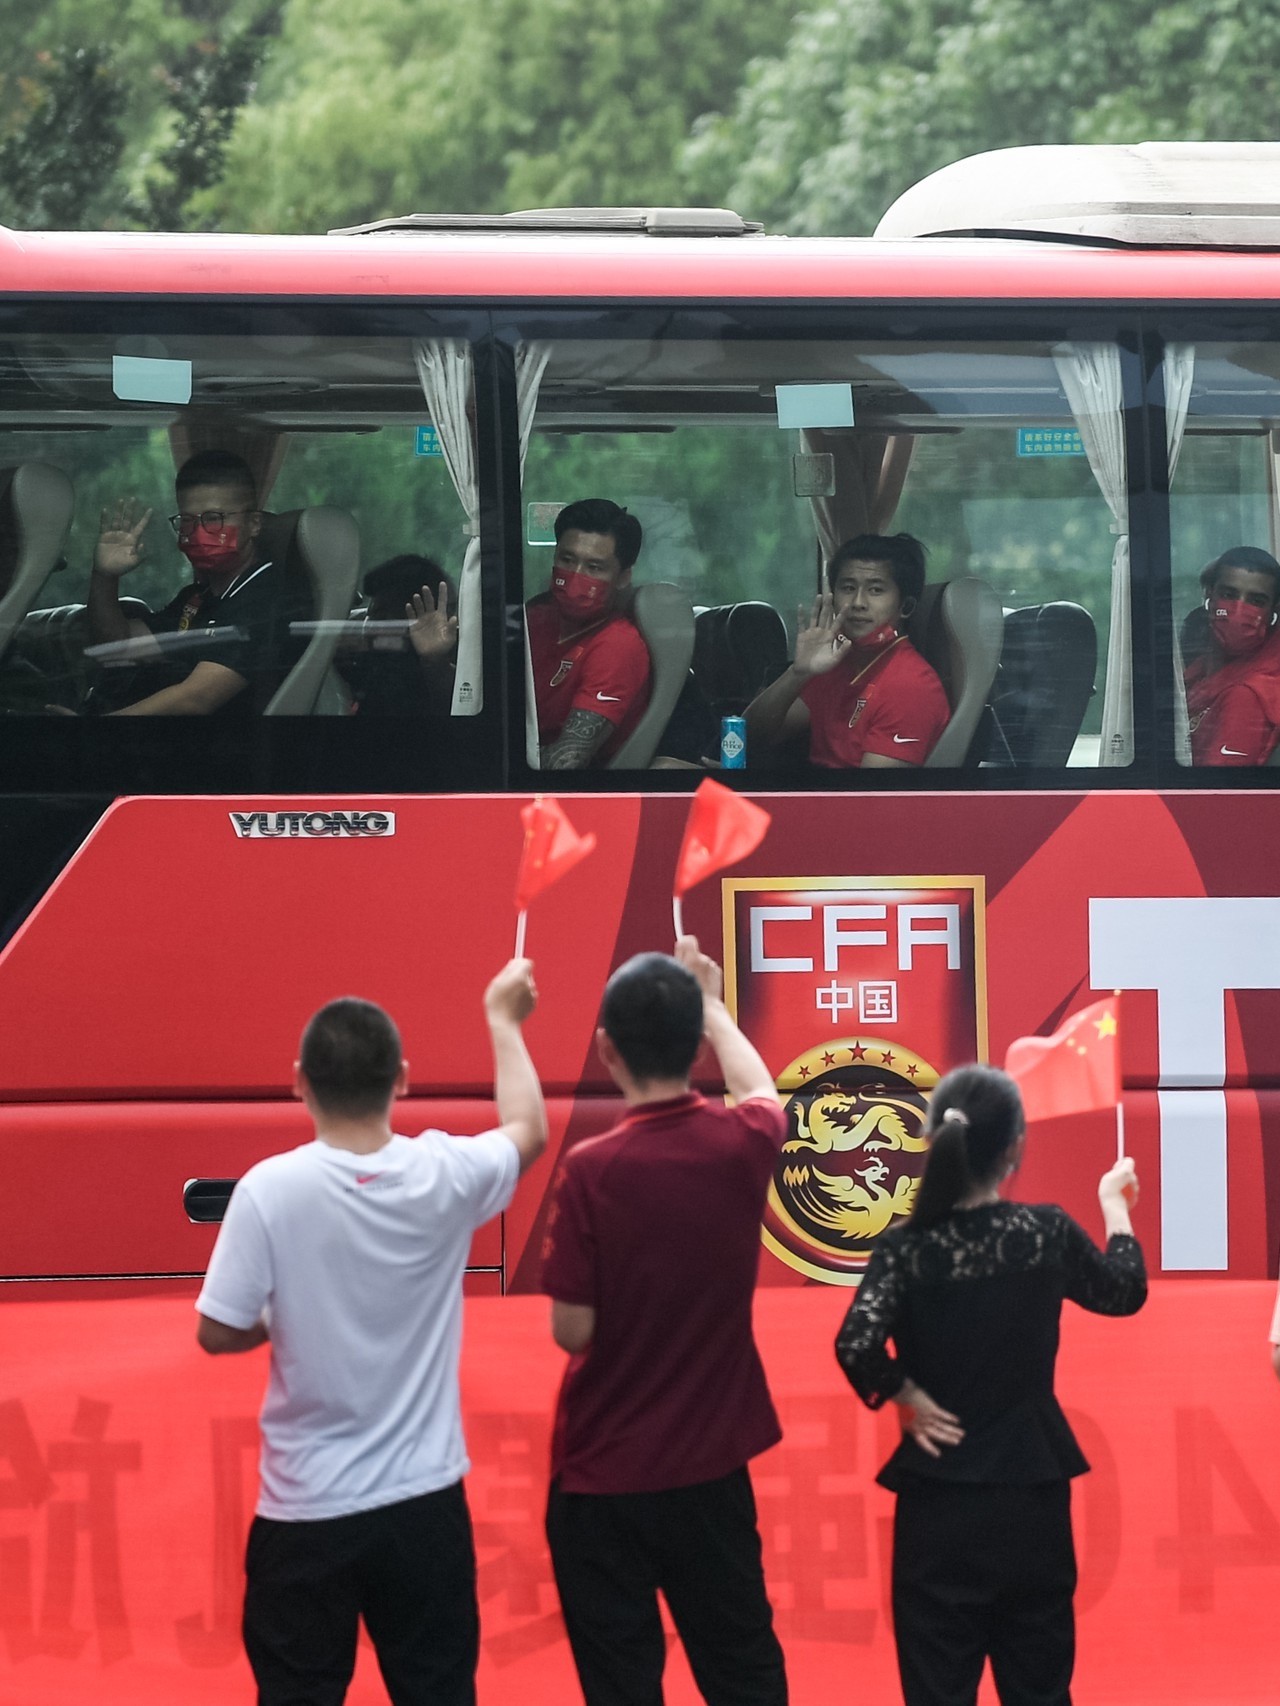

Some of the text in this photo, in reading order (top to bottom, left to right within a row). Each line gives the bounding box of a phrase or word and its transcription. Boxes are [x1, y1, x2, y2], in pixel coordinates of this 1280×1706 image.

[231, 811, 390, 837] YUTONG
[750, 903, 961, 973] CFA
[815, 979, 898, 1024] 中国
